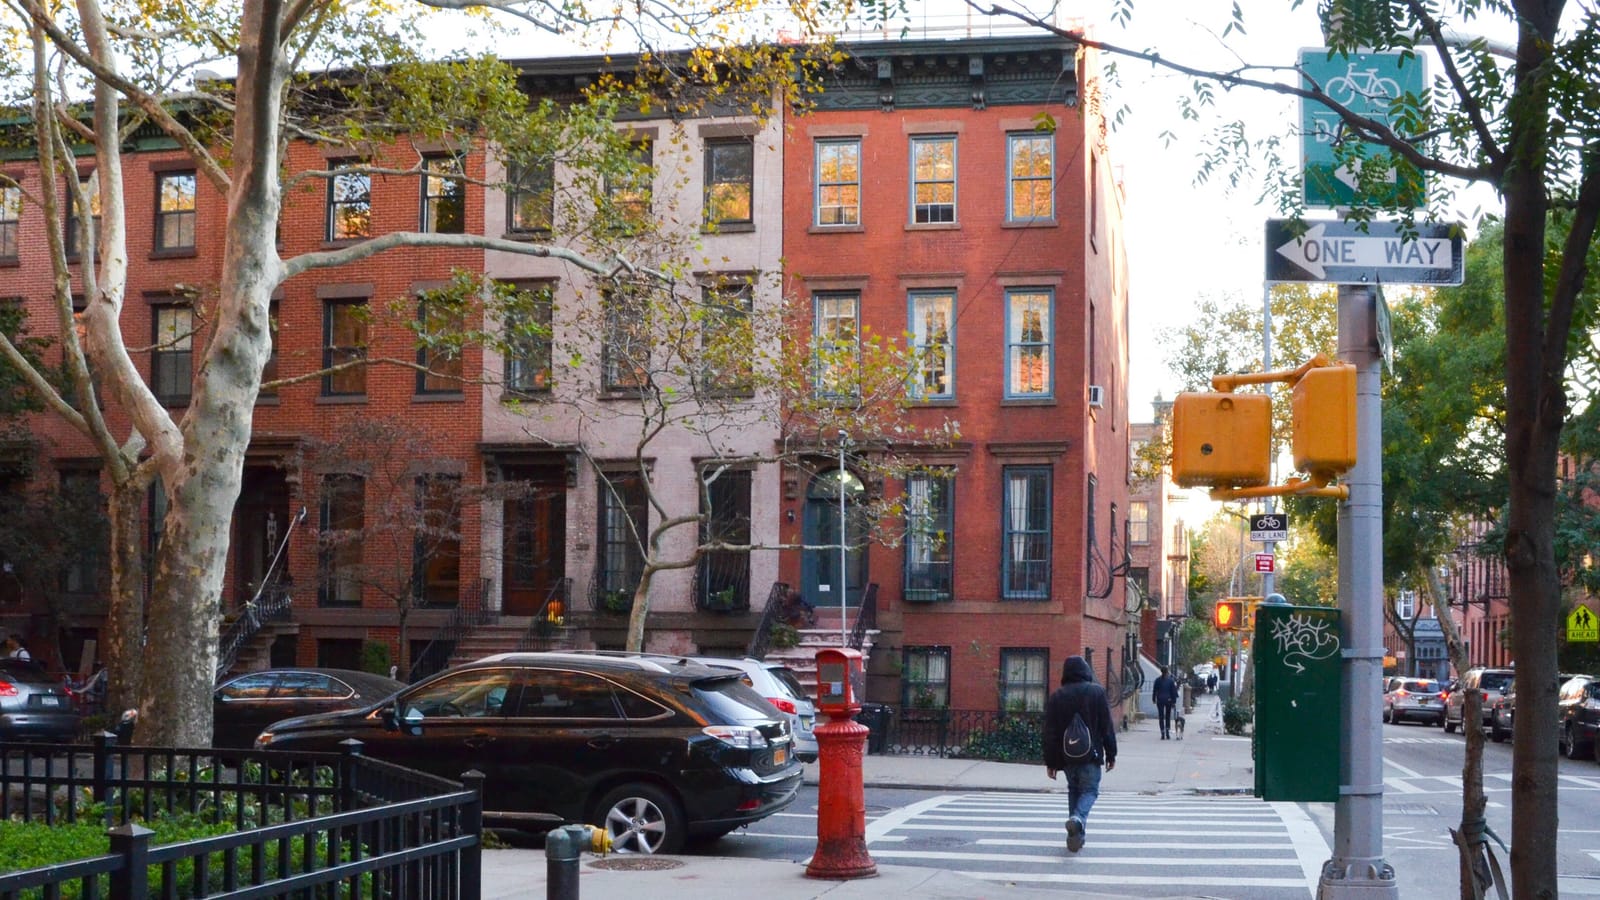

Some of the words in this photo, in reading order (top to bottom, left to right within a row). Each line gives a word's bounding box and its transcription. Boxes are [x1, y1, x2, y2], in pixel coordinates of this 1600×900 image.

[1303, 239, 1356, 264] ONE
[1384, 240, 1441, 265] WAY
[1252, 531, 1266, 539] BIKE
[1269, 531, 1285, 539] LANE
